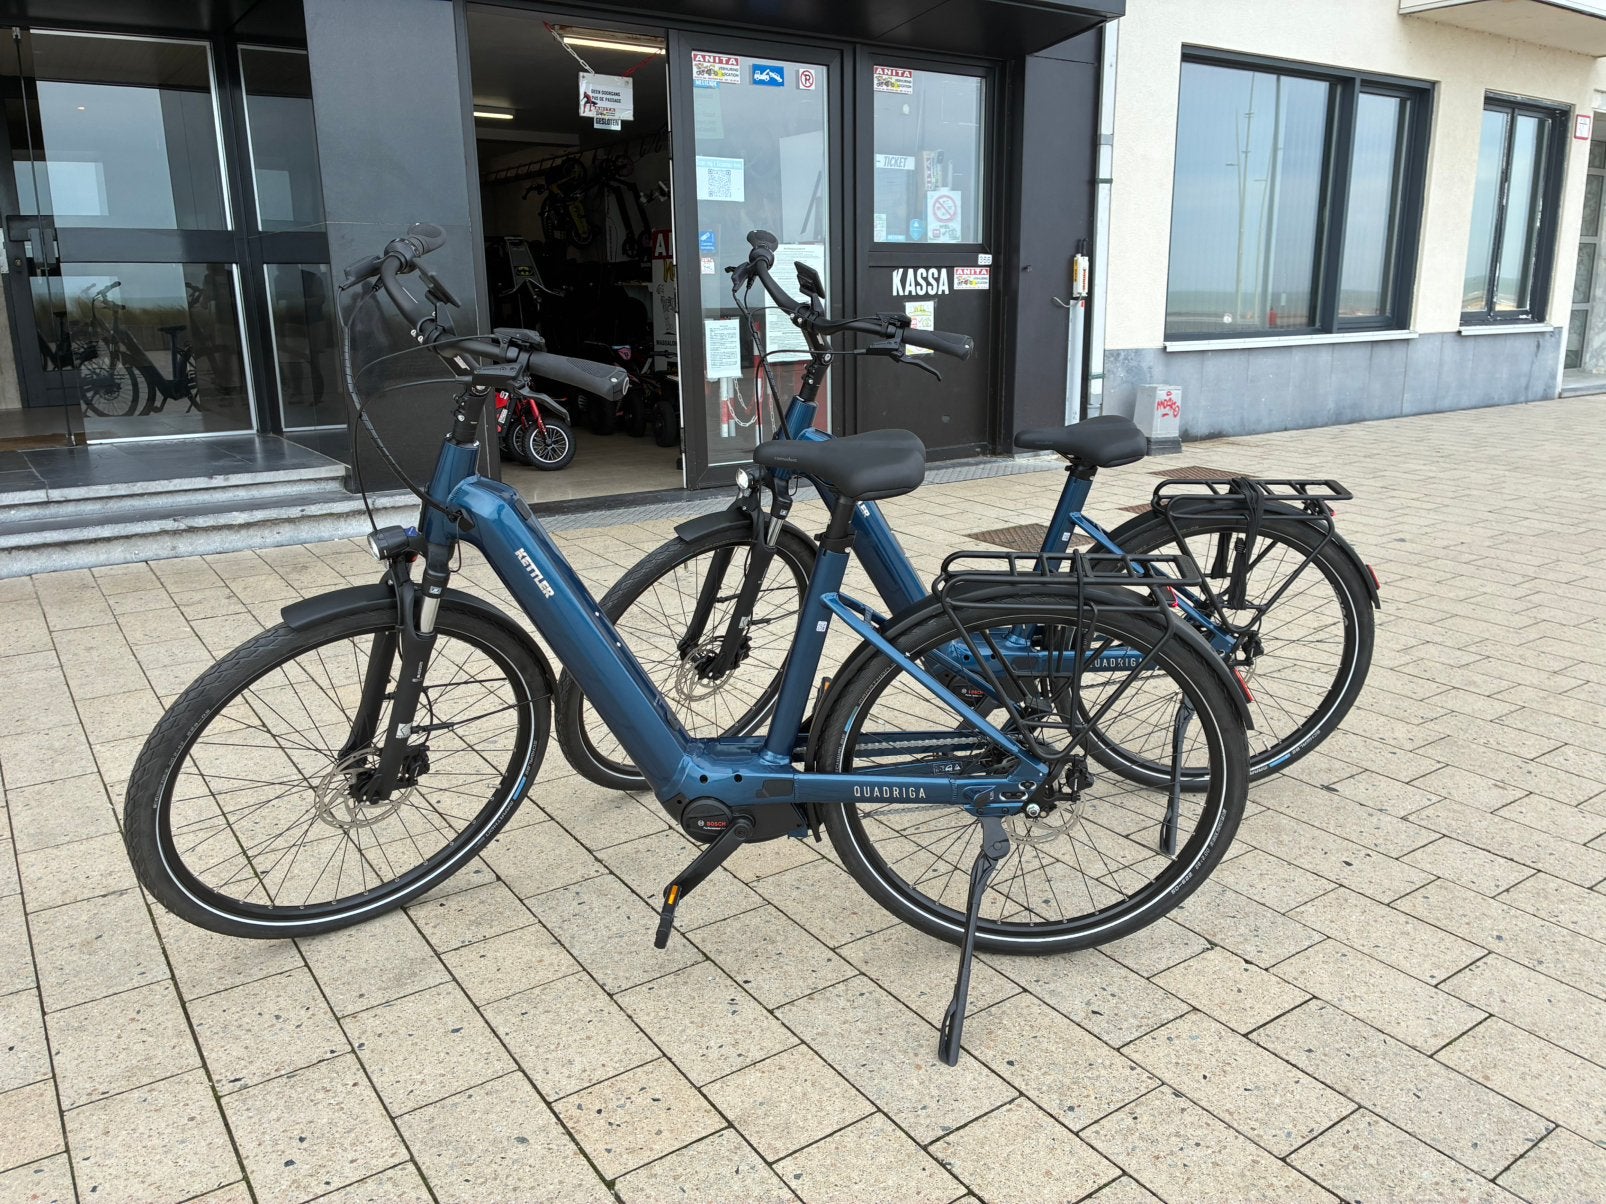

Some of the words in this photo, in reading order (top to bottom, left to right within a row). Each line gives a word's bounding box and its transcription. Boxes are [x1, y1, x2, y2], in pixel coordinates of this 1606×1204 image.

[694, 54, 738, 65] ANITA
[875, 68, 911, 78] ANITA
[595, 118, 619, 126] GESLOTEN
[884, 156, 908, 168] TICKET
[892, 268, 950, 296] KASSA
[514, 547, 555, 599] KETTLER
[1090, 658, 1143, 668] UADRIG
[853, 785, 926, 799] QUADRIGA
